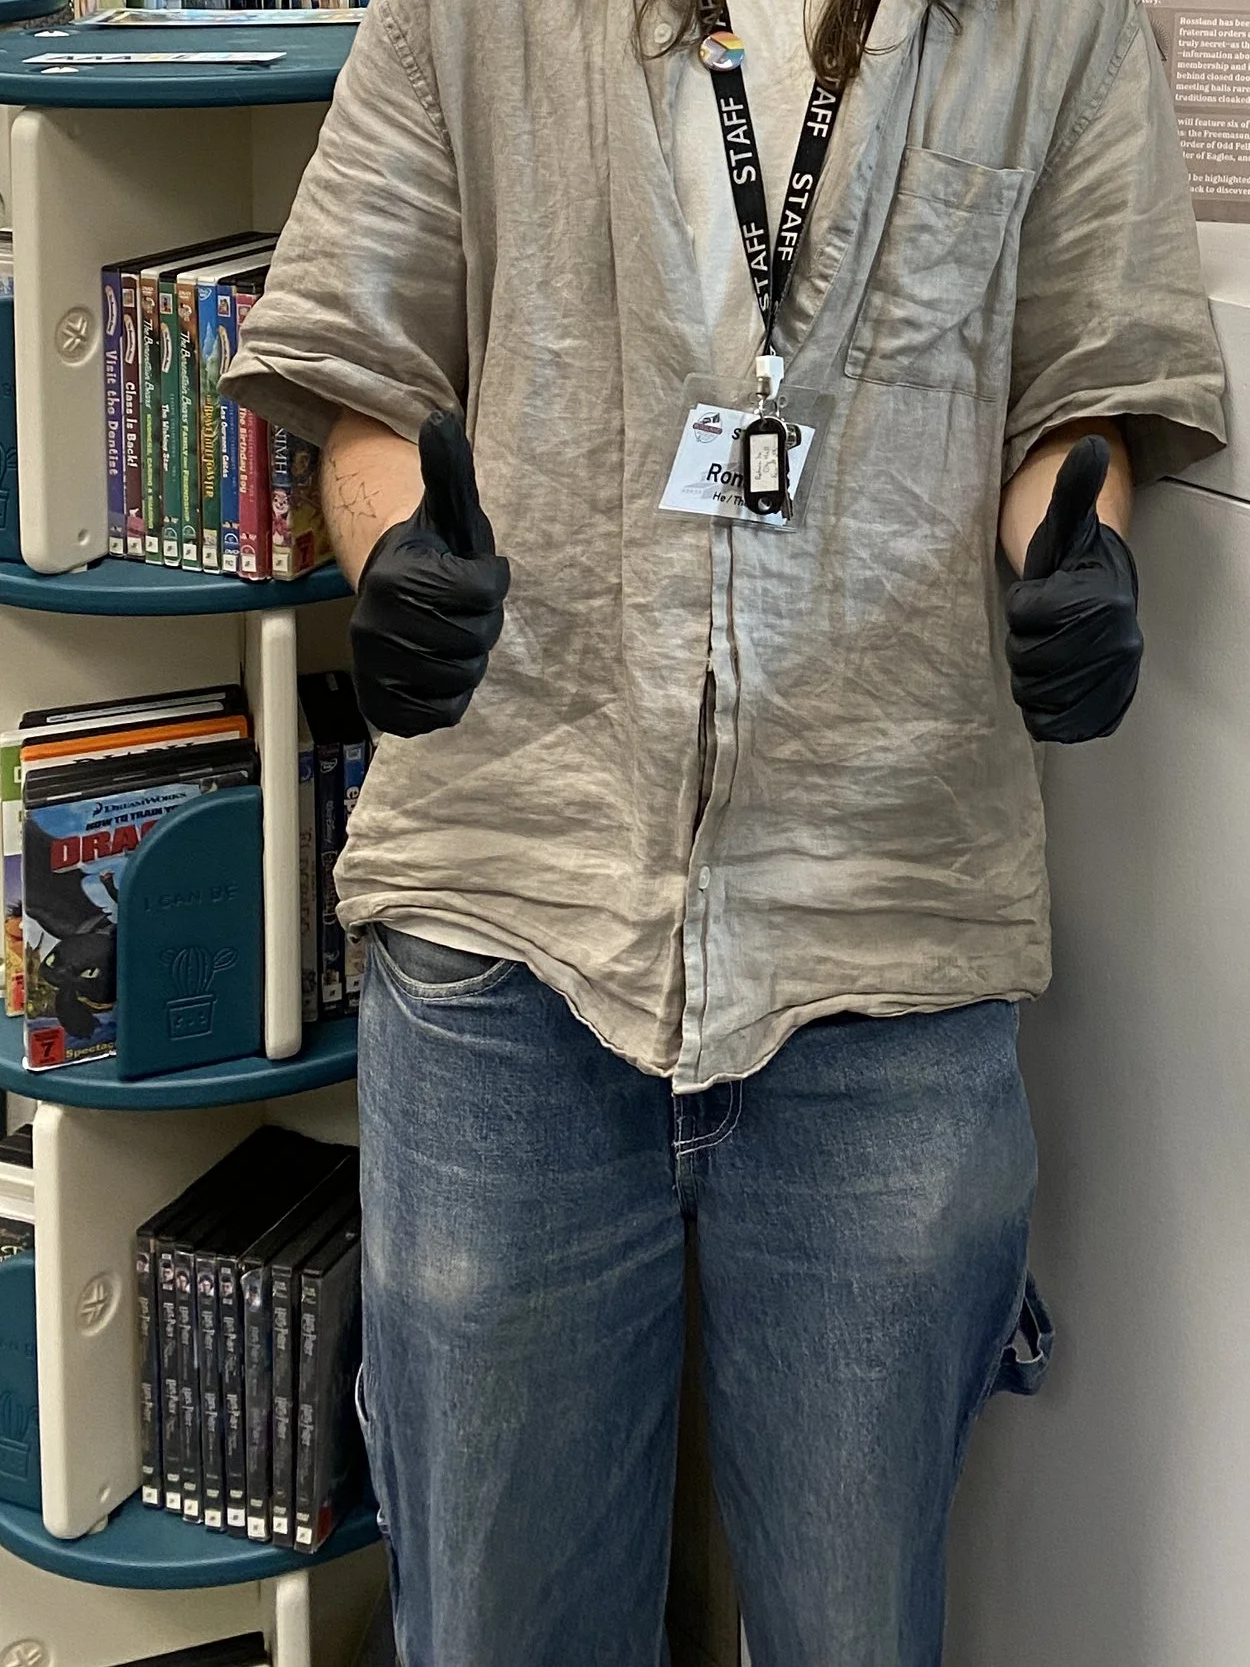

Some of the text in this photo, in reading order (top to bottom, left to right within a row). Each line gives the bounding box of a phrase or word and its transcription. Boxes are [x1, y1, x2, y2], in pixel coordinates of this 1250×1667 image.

[720, 97, 757, 185] STAFF
[1180, 140, 1204, 149] Order
[1206, 141, 1215, 149] of
[1216, 141, 1233, 150] Odd
[777, 172, 813, 261] STAFF
[743, 222, 770, 312] STAFF
[143, 319, 153, 337] The
[180, 331, 190, 348] The
[105, 350, 120, 475] Visit the Dentist
[125, 382, 136, 414] Class
[126, 433, 138, 467] Back!
[239, 428, 248, 472] Birthday
[86, 808, 163, 831] HOW TO TRAIN
[52, 820, 159, 870] DRA
[41, 1041, 54, 1057] 7
[65, 1042, 115, 1057] Spectac
